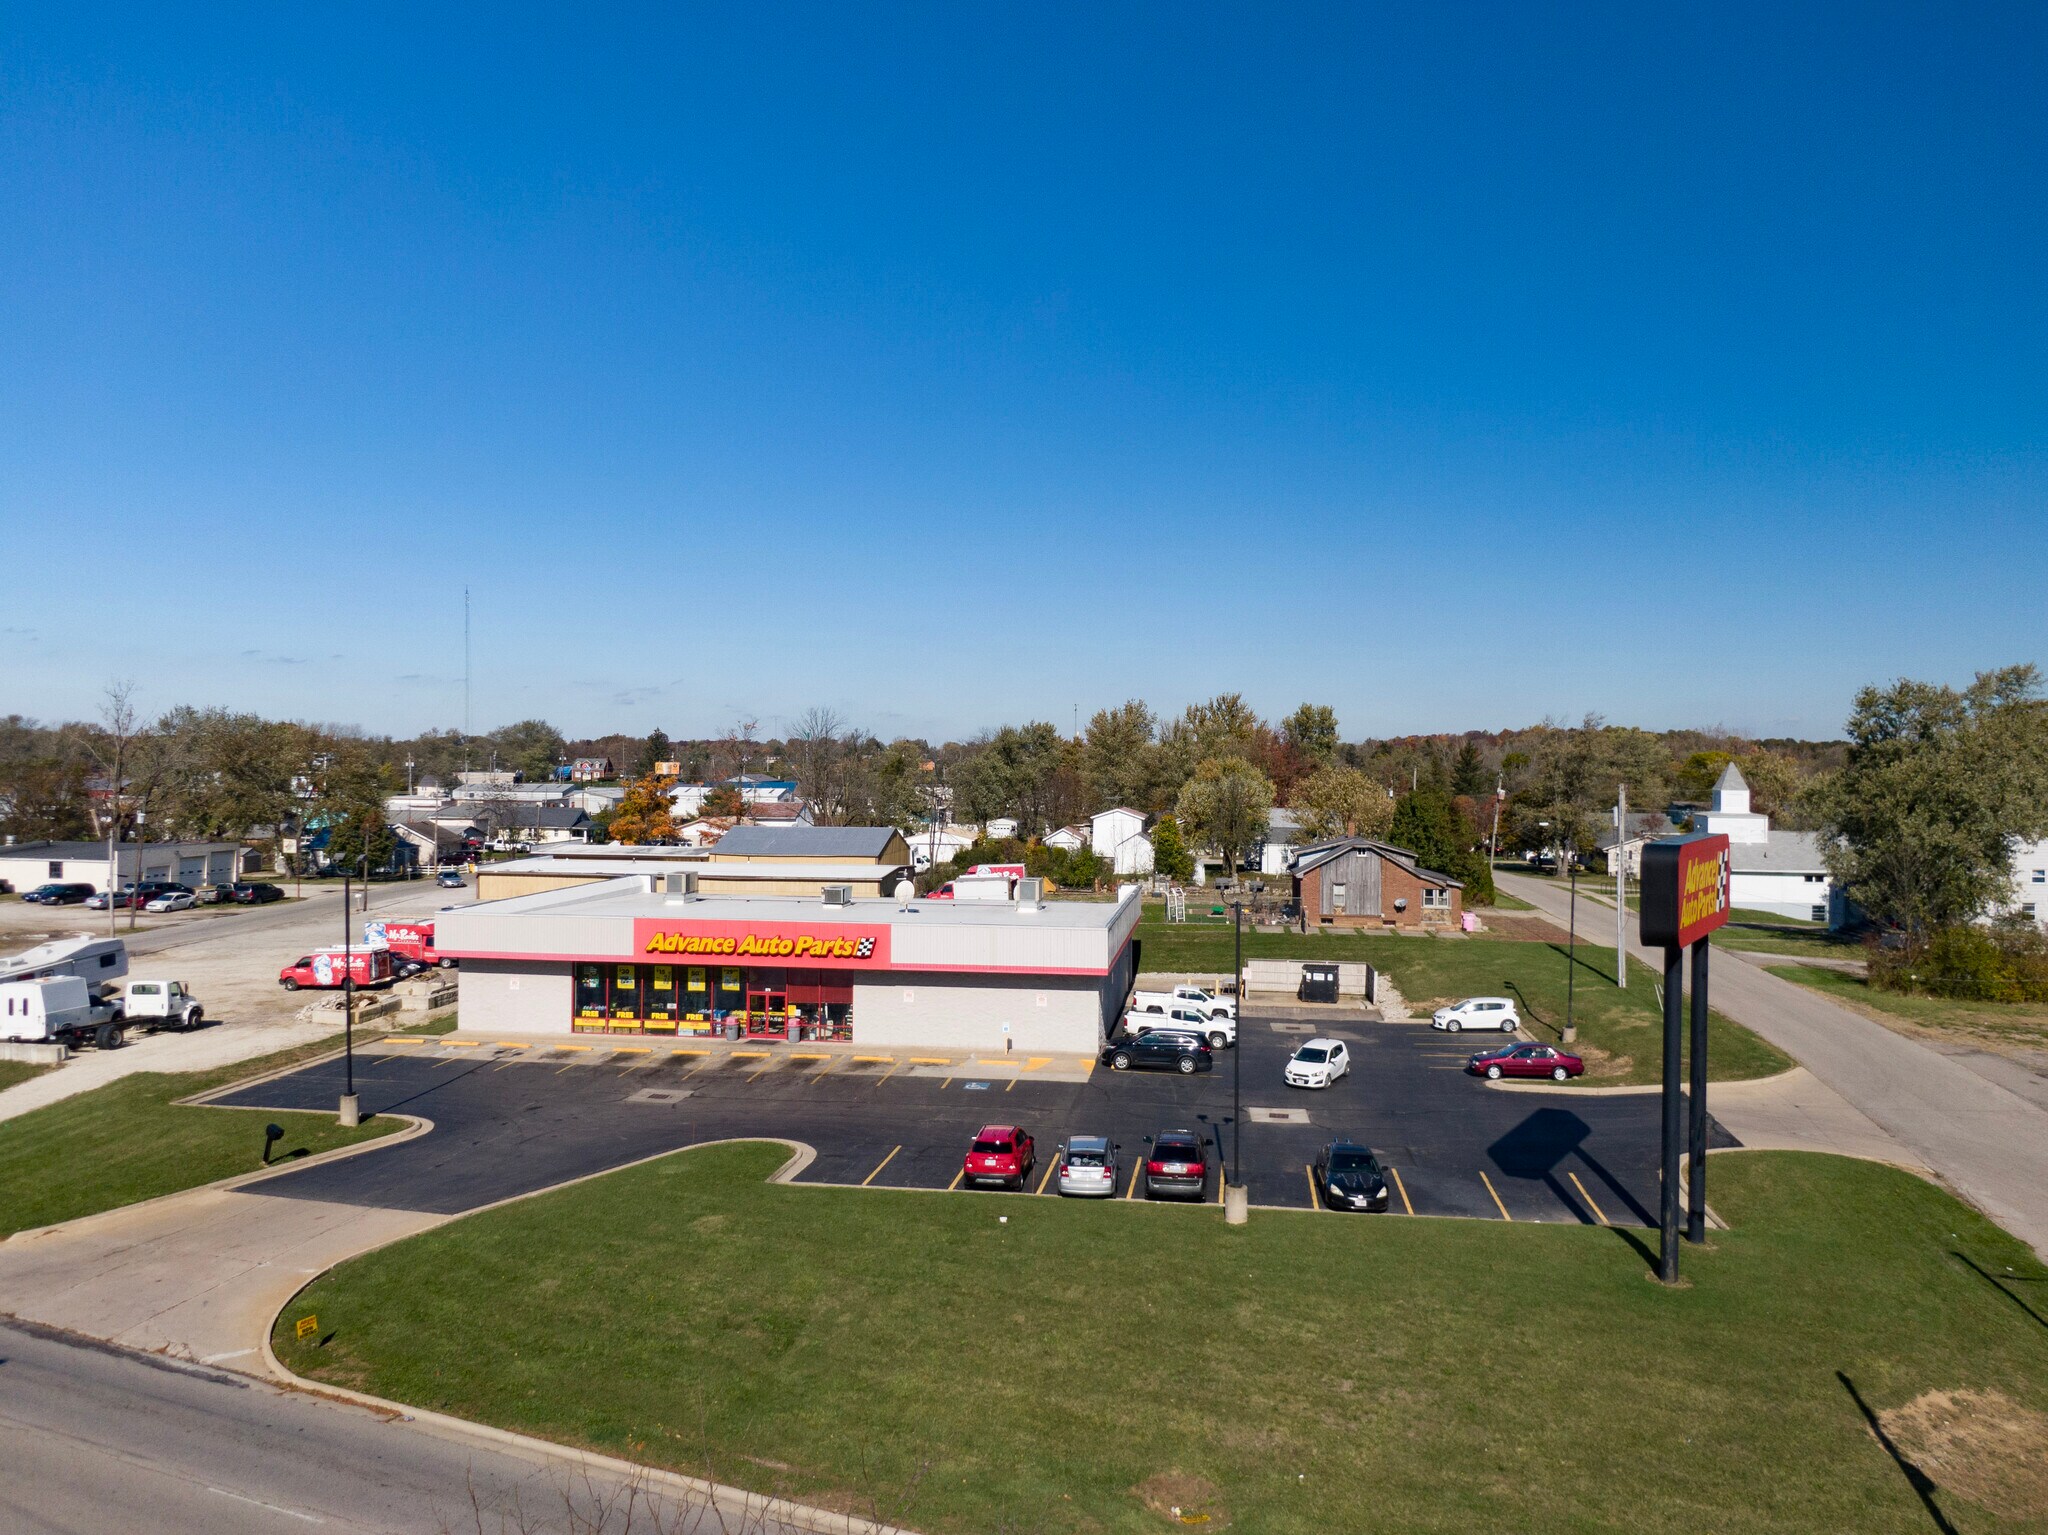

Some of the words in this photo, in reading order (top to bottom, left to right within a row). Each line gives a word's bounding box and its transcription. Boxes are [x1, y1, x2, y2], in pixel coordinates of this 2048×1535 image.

[1684, 856, 1717, 896] Advance
[1680, 895, 1698, 930] Auto
[1697, 887, 1716, 919] Parts
[646, 932, 736, 954] Advance
[736, 934, 794, 956] Auto
[795, 936, 855, 958] Parts
[581, 1010, 599, 1018] FREE
[616, 1011, 634, 1019] FREE
[651, 1012, 669, 1020] FREE
[686, 1013, 704, 1021] FREE
